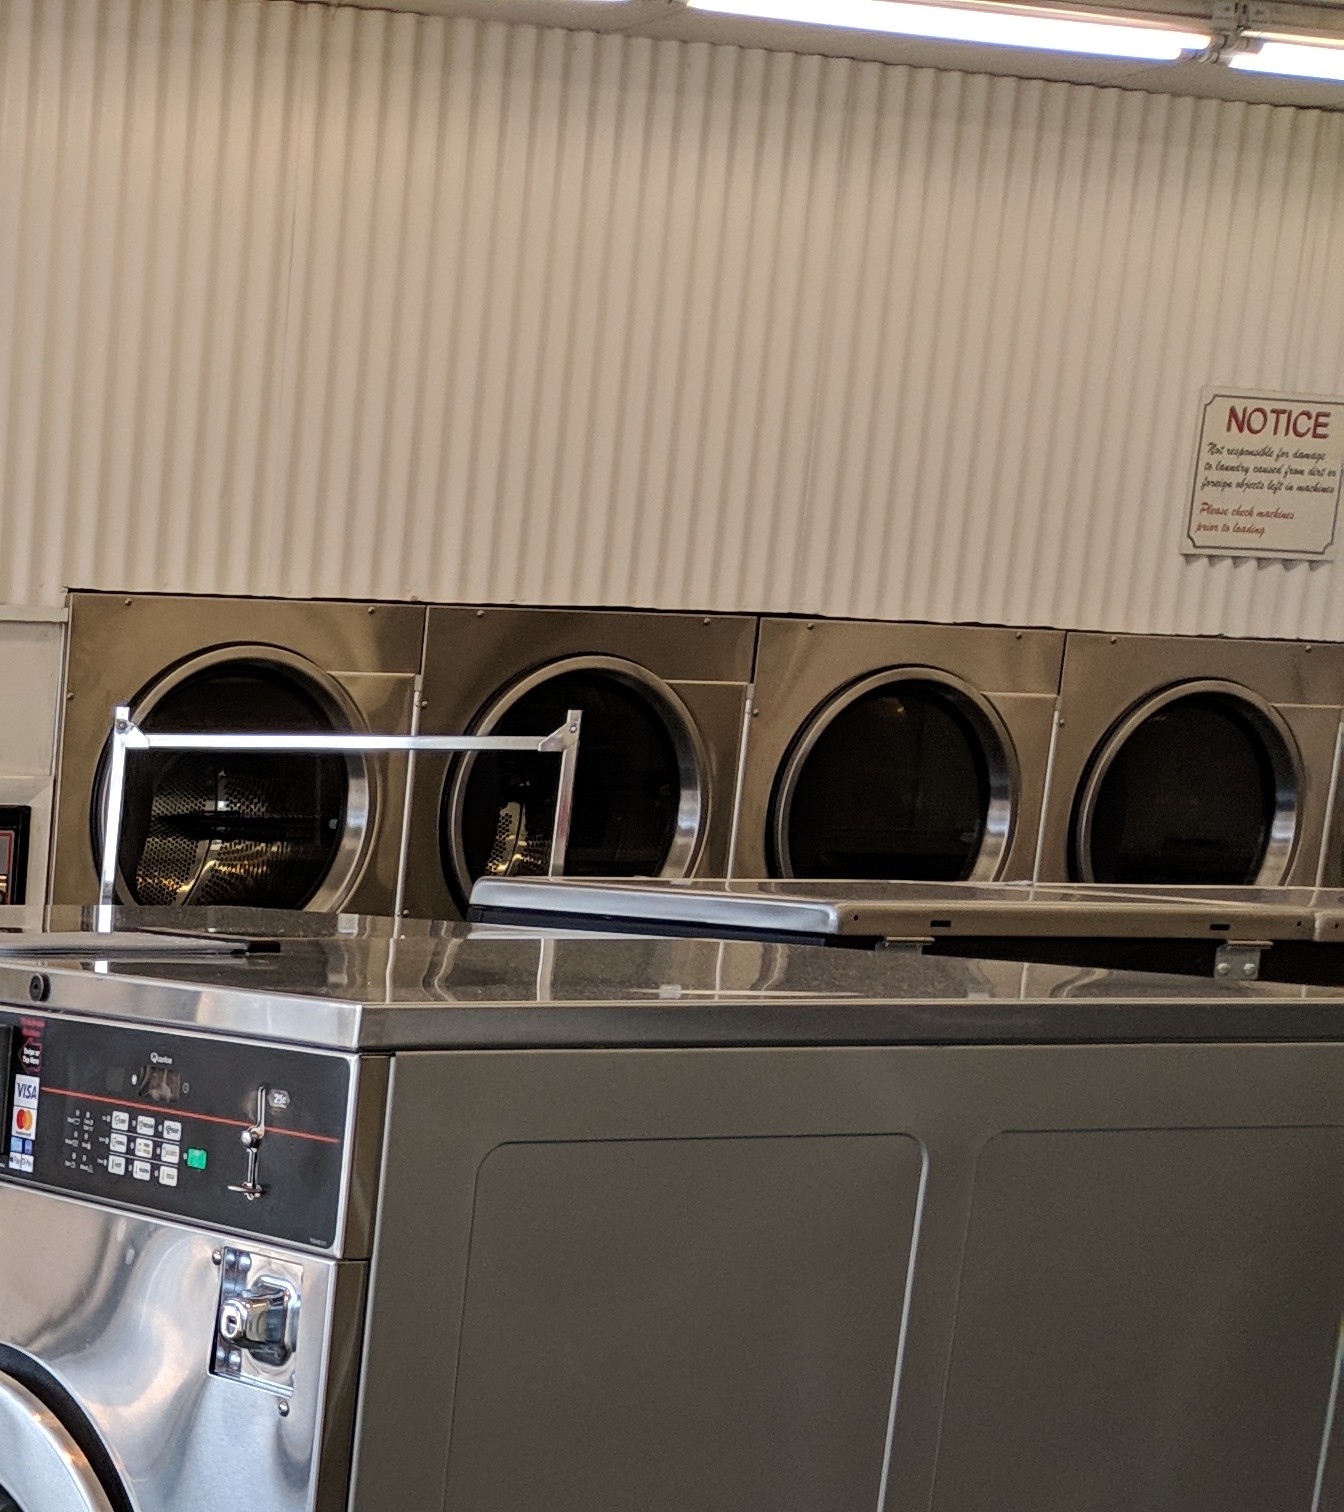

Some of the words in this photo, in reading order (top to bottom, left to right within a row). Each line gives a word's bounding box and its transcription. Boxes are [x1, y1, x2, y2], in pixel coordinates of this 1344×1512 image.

[1226, 405, 1331, 439] NOTICE
[1208, 442, 1224, 455] Not
[1227, 445, 1274, 459] responsible
[1276, 447, 1289, 462] for
[1293, 448, 1326, 463] damage
[1204, 462, 1212, 471] to
[1215, 460, 1250, 476] laundry
[1253, 464, 1281, 474] caused
[1283, 464, 1304, 479] from
[1308, 466, 1325, 477] dirt
[1201, 476, 1232, 492] foreign
[1235, 477, 1265, 493] objects
[1267, 479, 1283, 494] left
[1285, 482, 1294, 491] in
[1296, 481, 1335, 494] machines
[1200, 501, 1229, 516] Please
[1232, 504, 1254, 517] check
[1256, 506, 1295, 520] machines
[1195, 521, 1218, 533] prior
[1221, 523, 1230, 532] to
[1233, 521, 1265, 538] loading
[17, 1082, 37, 1100] VISA
